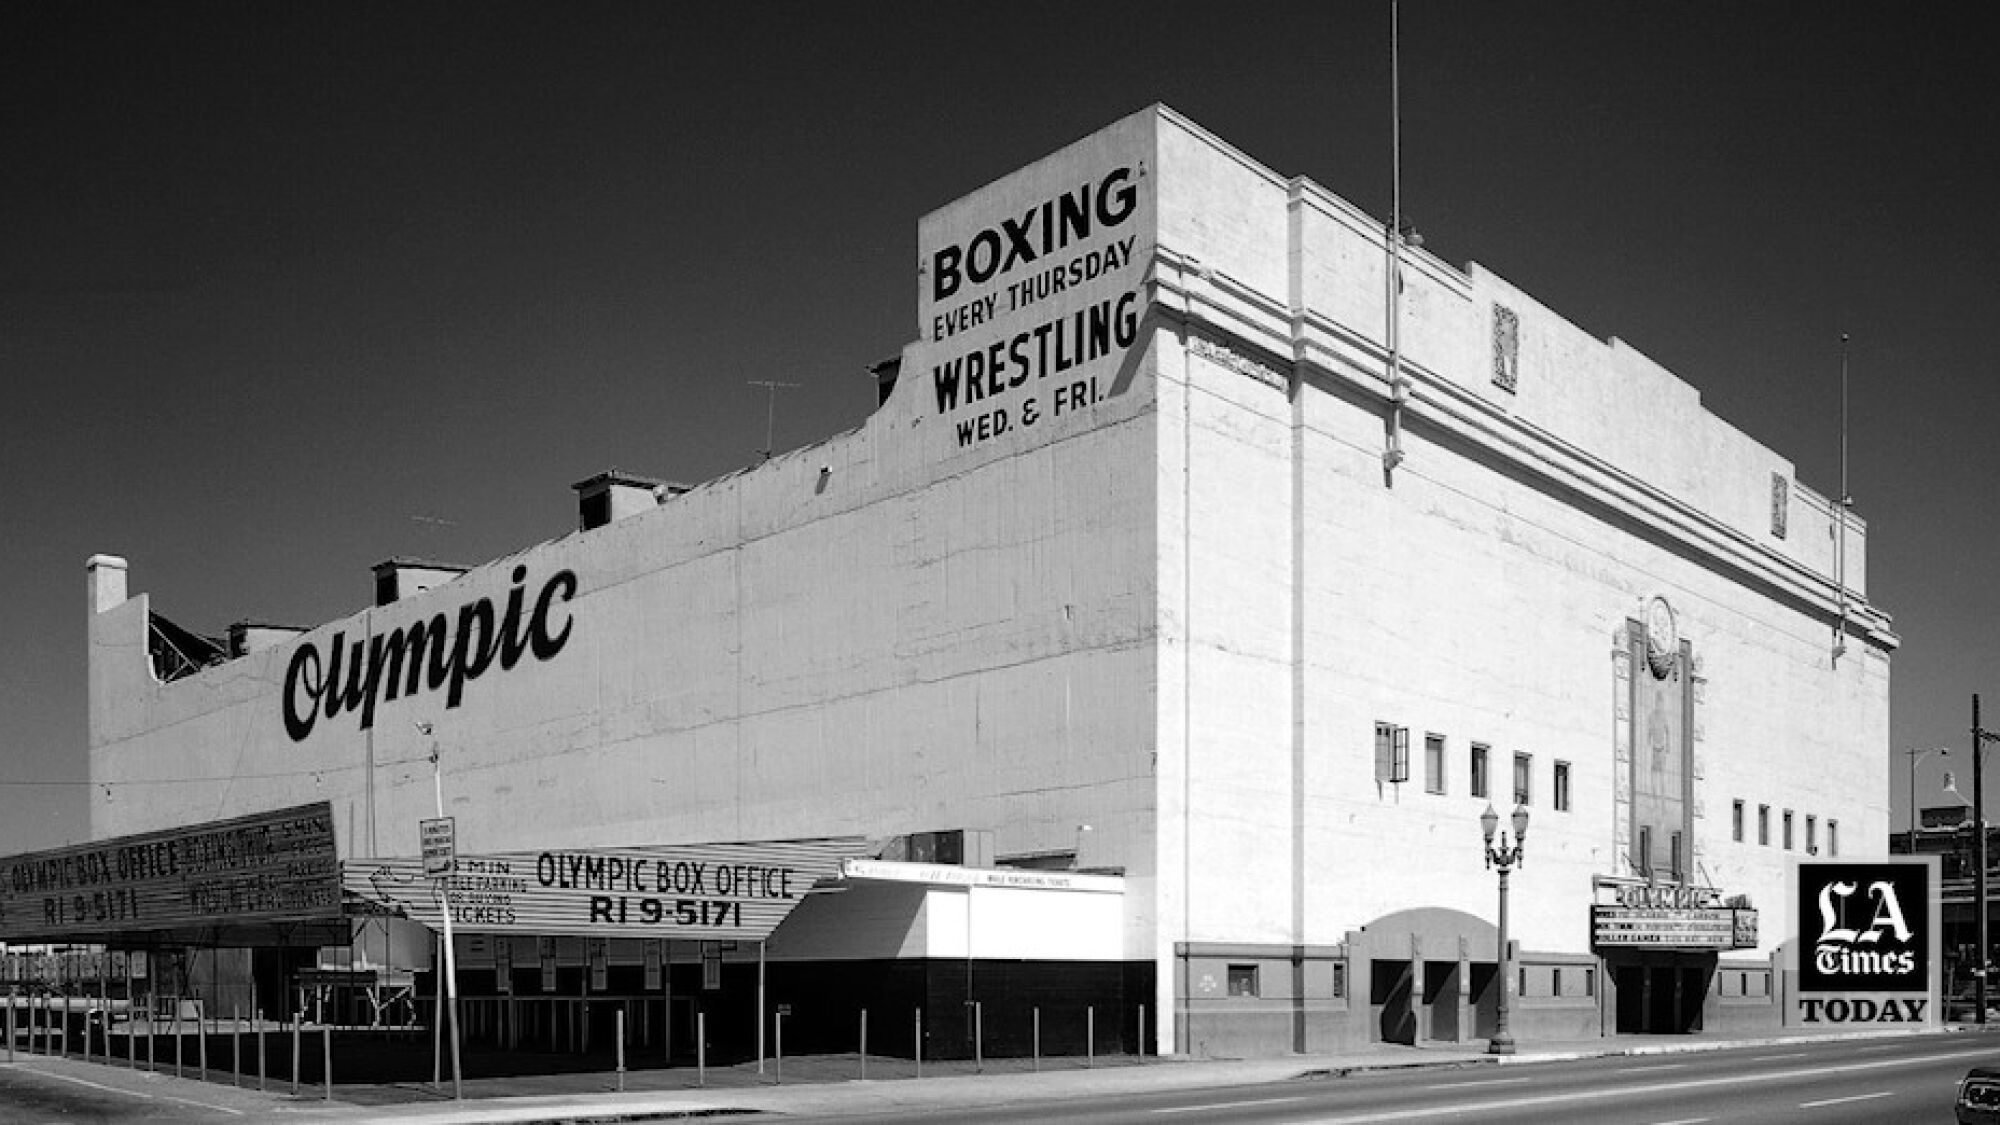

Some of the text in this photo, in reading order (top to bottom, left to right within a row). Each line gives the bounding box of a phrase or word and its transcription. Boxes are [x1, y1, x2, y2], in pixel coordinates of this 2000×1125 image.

[933, 167, 1137, 302] BOXING
[933, 235, 1136, 342] EVERY THURSDAY
[933, 291, 1137, 414] WRESTLING
[956, 376, 1105, 447] WED. & FRI.
[283, 565, 577, 742] Olympic
[11, 859, 72, 893] OLYMPIC
[76, 851, 111, 886] BOX
[118, 841, 178, 880] OFFICE
[537, 852, 794, 899] OLYMPIC BOX OFFICE
[44, 896, 64, 926] RI
[590, 896, 740, 927] RI 9-5171
